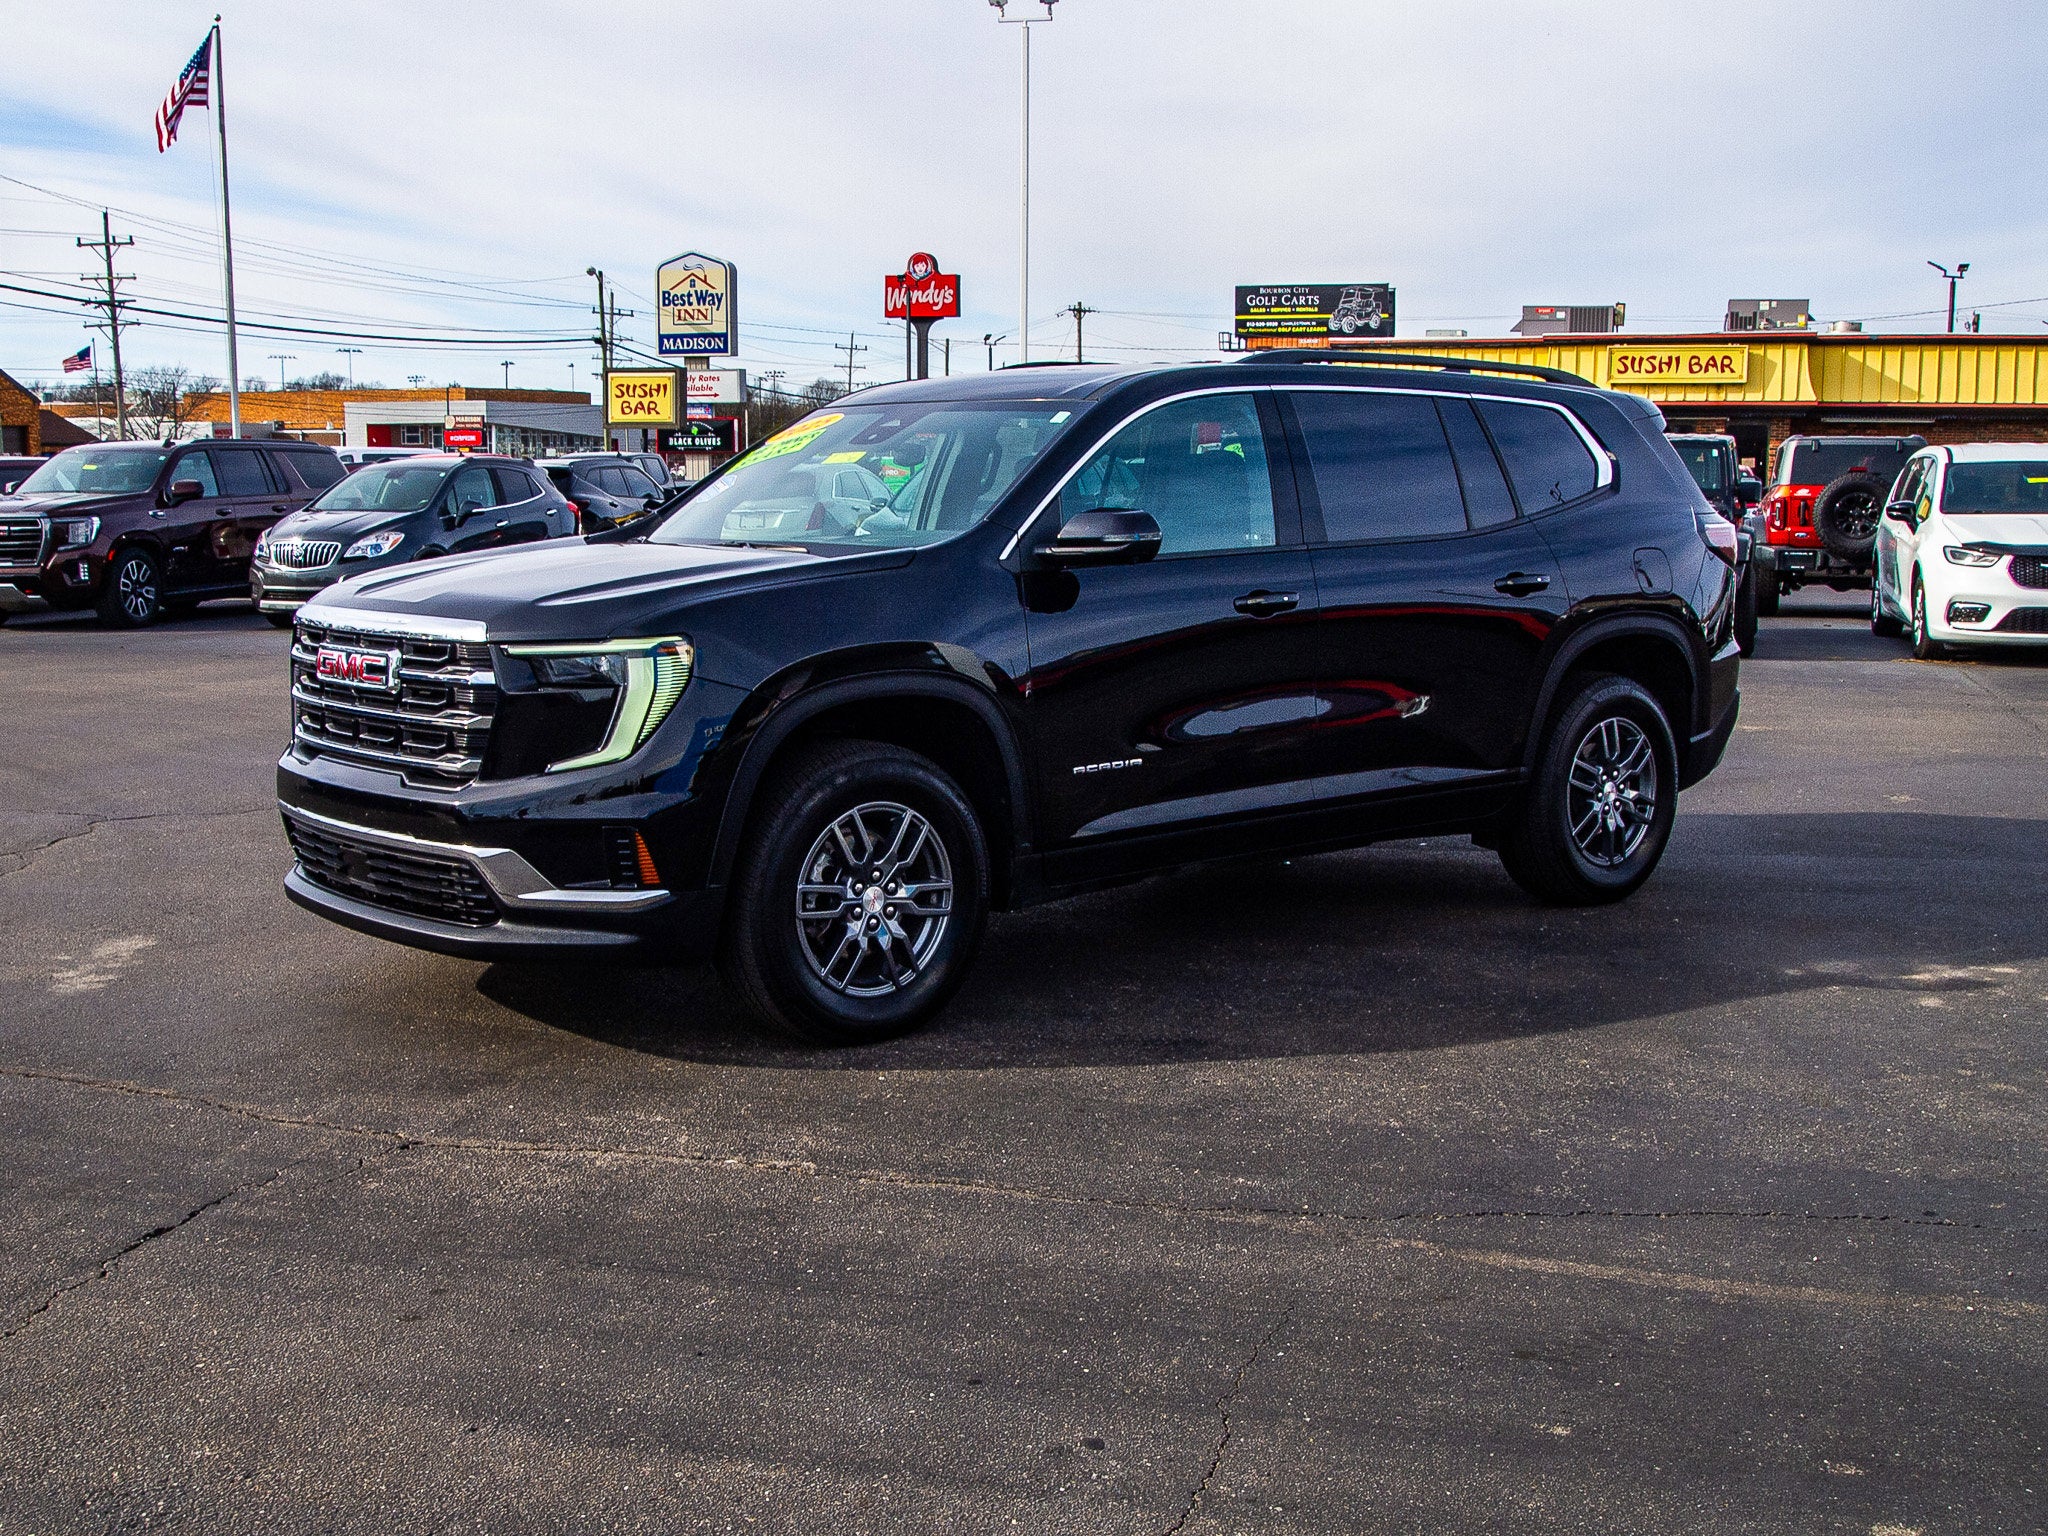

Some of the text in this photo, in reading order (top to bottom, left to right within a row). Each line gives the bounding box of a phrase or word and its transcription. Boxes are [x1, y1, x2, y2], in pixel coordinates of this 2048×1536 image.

[1293, 286, 1310, 294] CITY
[662, 290, 724, 311] Best Way
[1246, 294, 1320, 305] GOLF CARTS
[676, 308, 709, 321] INN
[662, 337, 724, 350] MADISON
[1616, 355, 1736, 374] SUSHI BAR
[698, 374, 720, 382] Rates
[615, 383, 668, 399] SUSHI
[620, 400, 661, 415] BAR
[668, 437, 721, 446] BLACK OLIVES
[317, 650, 385, 683] GMC
[1073, 758, 1143, 774] ACADIA
